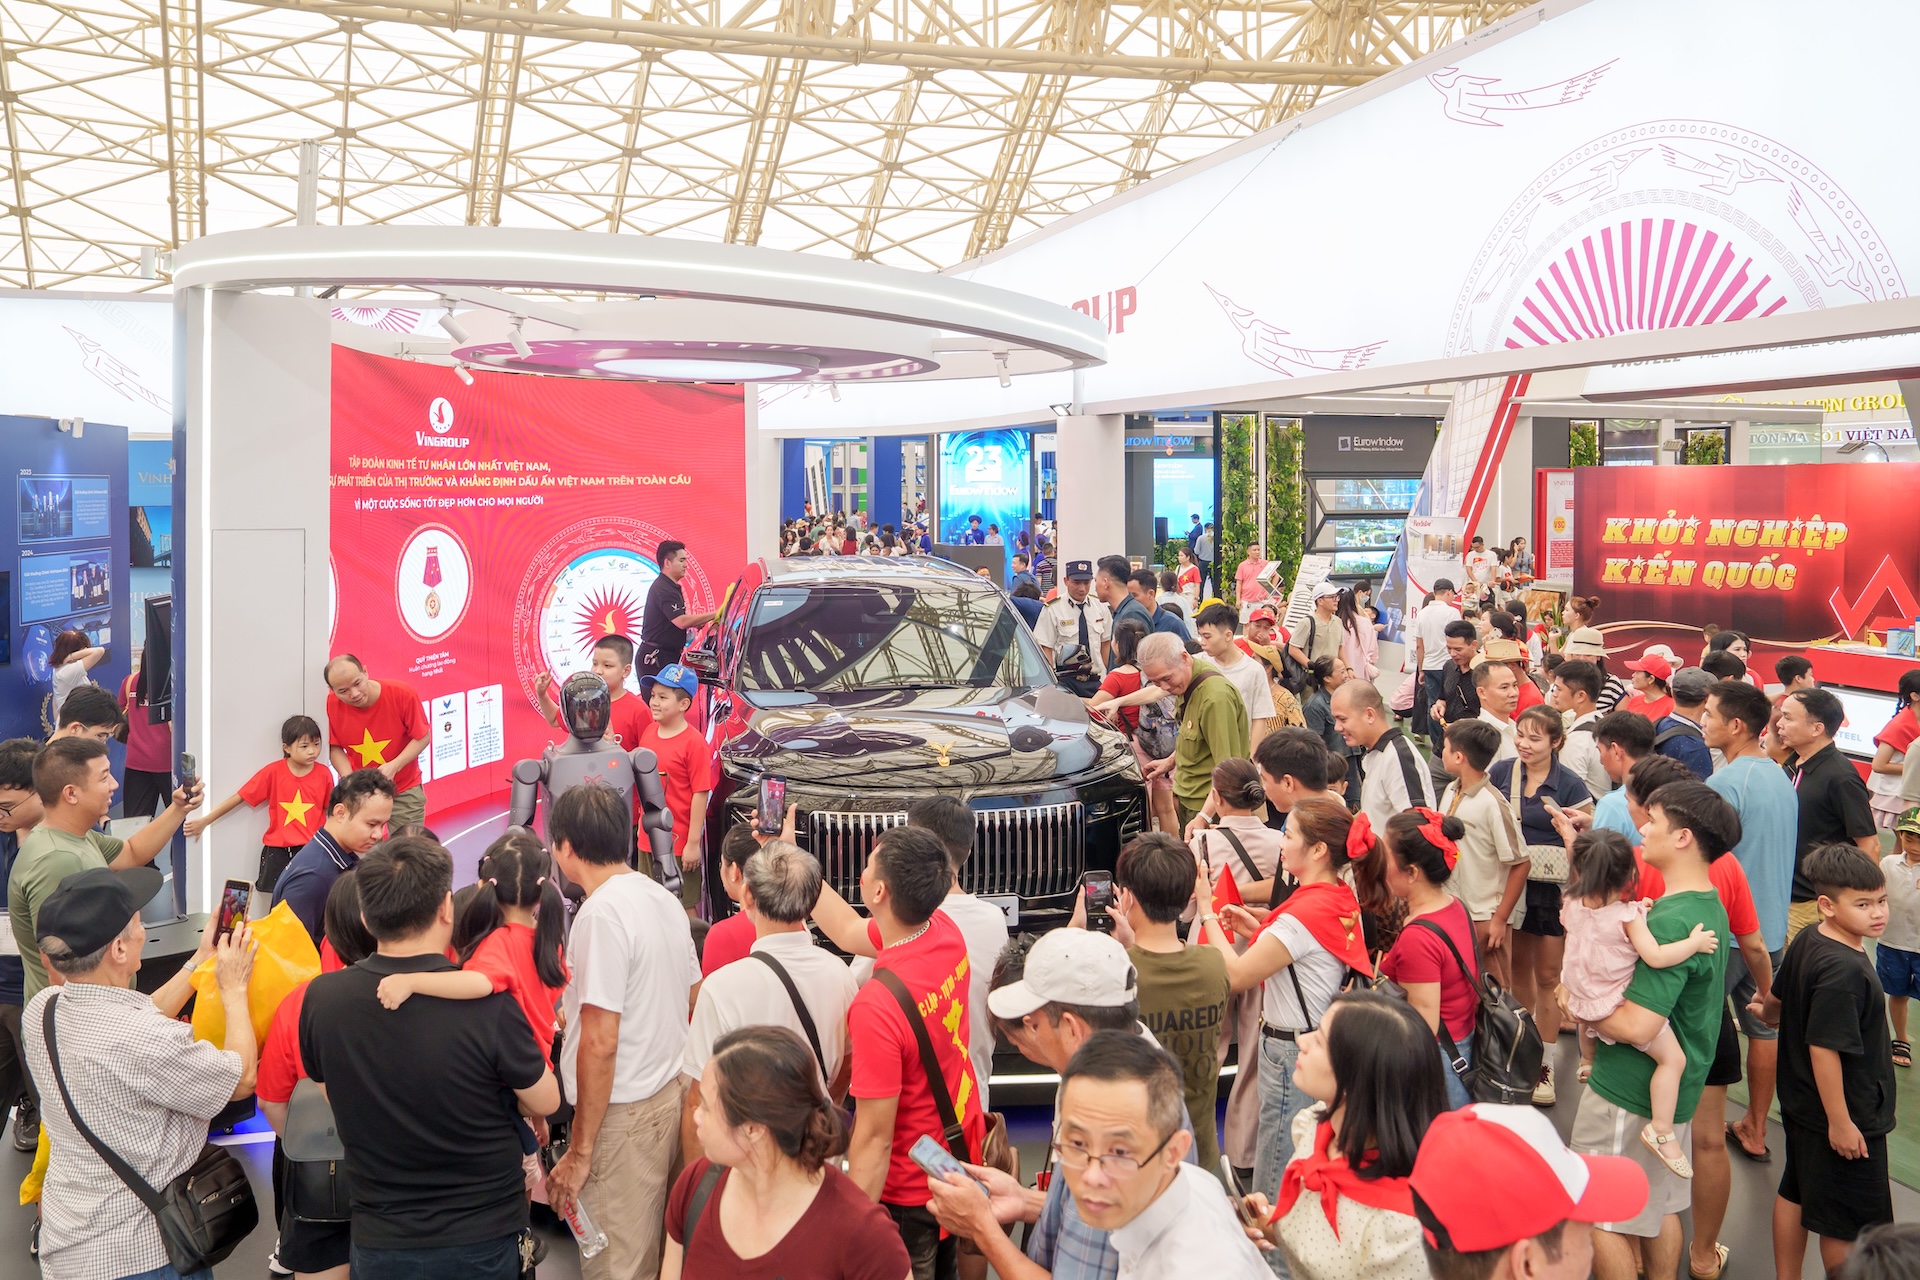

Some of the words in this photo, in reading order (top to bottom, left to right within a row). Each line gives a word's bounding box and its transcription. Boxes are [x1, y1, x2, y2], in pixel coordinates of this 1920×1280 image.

[416, 430, 470, 448] VINGROUP
[1354, 436, 1404, 447] Eurowindow
[1846, 427, 1882, 442] VIỆT
[349, 456, 361, 470] TẬP
[362, 456, 384, 468] ĐOÀN
[386, 459, 404, 469] KINH
[406, 457, 417, 469] TẾ
[418, 459, 429, 470] TƯ
[430, 458, 456, 470] NHÂN
[458, 459, 476, 470] LỚN
[478, 458, 502, 471] NHẤT
[504, 460, 524, 472] VIỆT
[526, 462, 551, 472] NAM,
[338, 473, 354, 486] PHÁT
[378, 473, 393, 486] CỦA
[394, 477, 407, 488] THỊ
[409, 476, 443, 487] TRƯỜNG
[446, 476, 458, 486] VÀ
[460, 474, 490, 486] KHẲNG
[493, 477, 516, 488] ĐỊNH
[518, 474, 538, 486] DẤU
[540, 474, 555, 486] ẤN
[557, 475, 578, 487] VIỆT
[580, 477, 604, 486] NAM
[607, 475, 634, 486] TRÊN
[636, 474, 666, 485] TOÀN
[669, 474, 692, 484] CẦU
[354, 498, 360, 510] VÌ
[362, 498, 378, 512] MỘT
[379, 497, 398, 511] CUỘC
[400, 496, 422, 508] SỐNG
[423, 496, 436, 508] TỐT
[438, 498, 455, 508] ĐẸP
[458, 496, 476, 506] HƠN
[478, 498, 495, 506] CHO
[498, 498, 514, 508] MỌI
[516, 495, 544, 506] NGƯỜI
[1602, 510, 1702, 545] KHỞI
[1705, 514, 1848, 556] NGHIỆP
[1602, 550, 1698, 586] KIẾN
[1702, 553, 1798, 590] QUỐC
